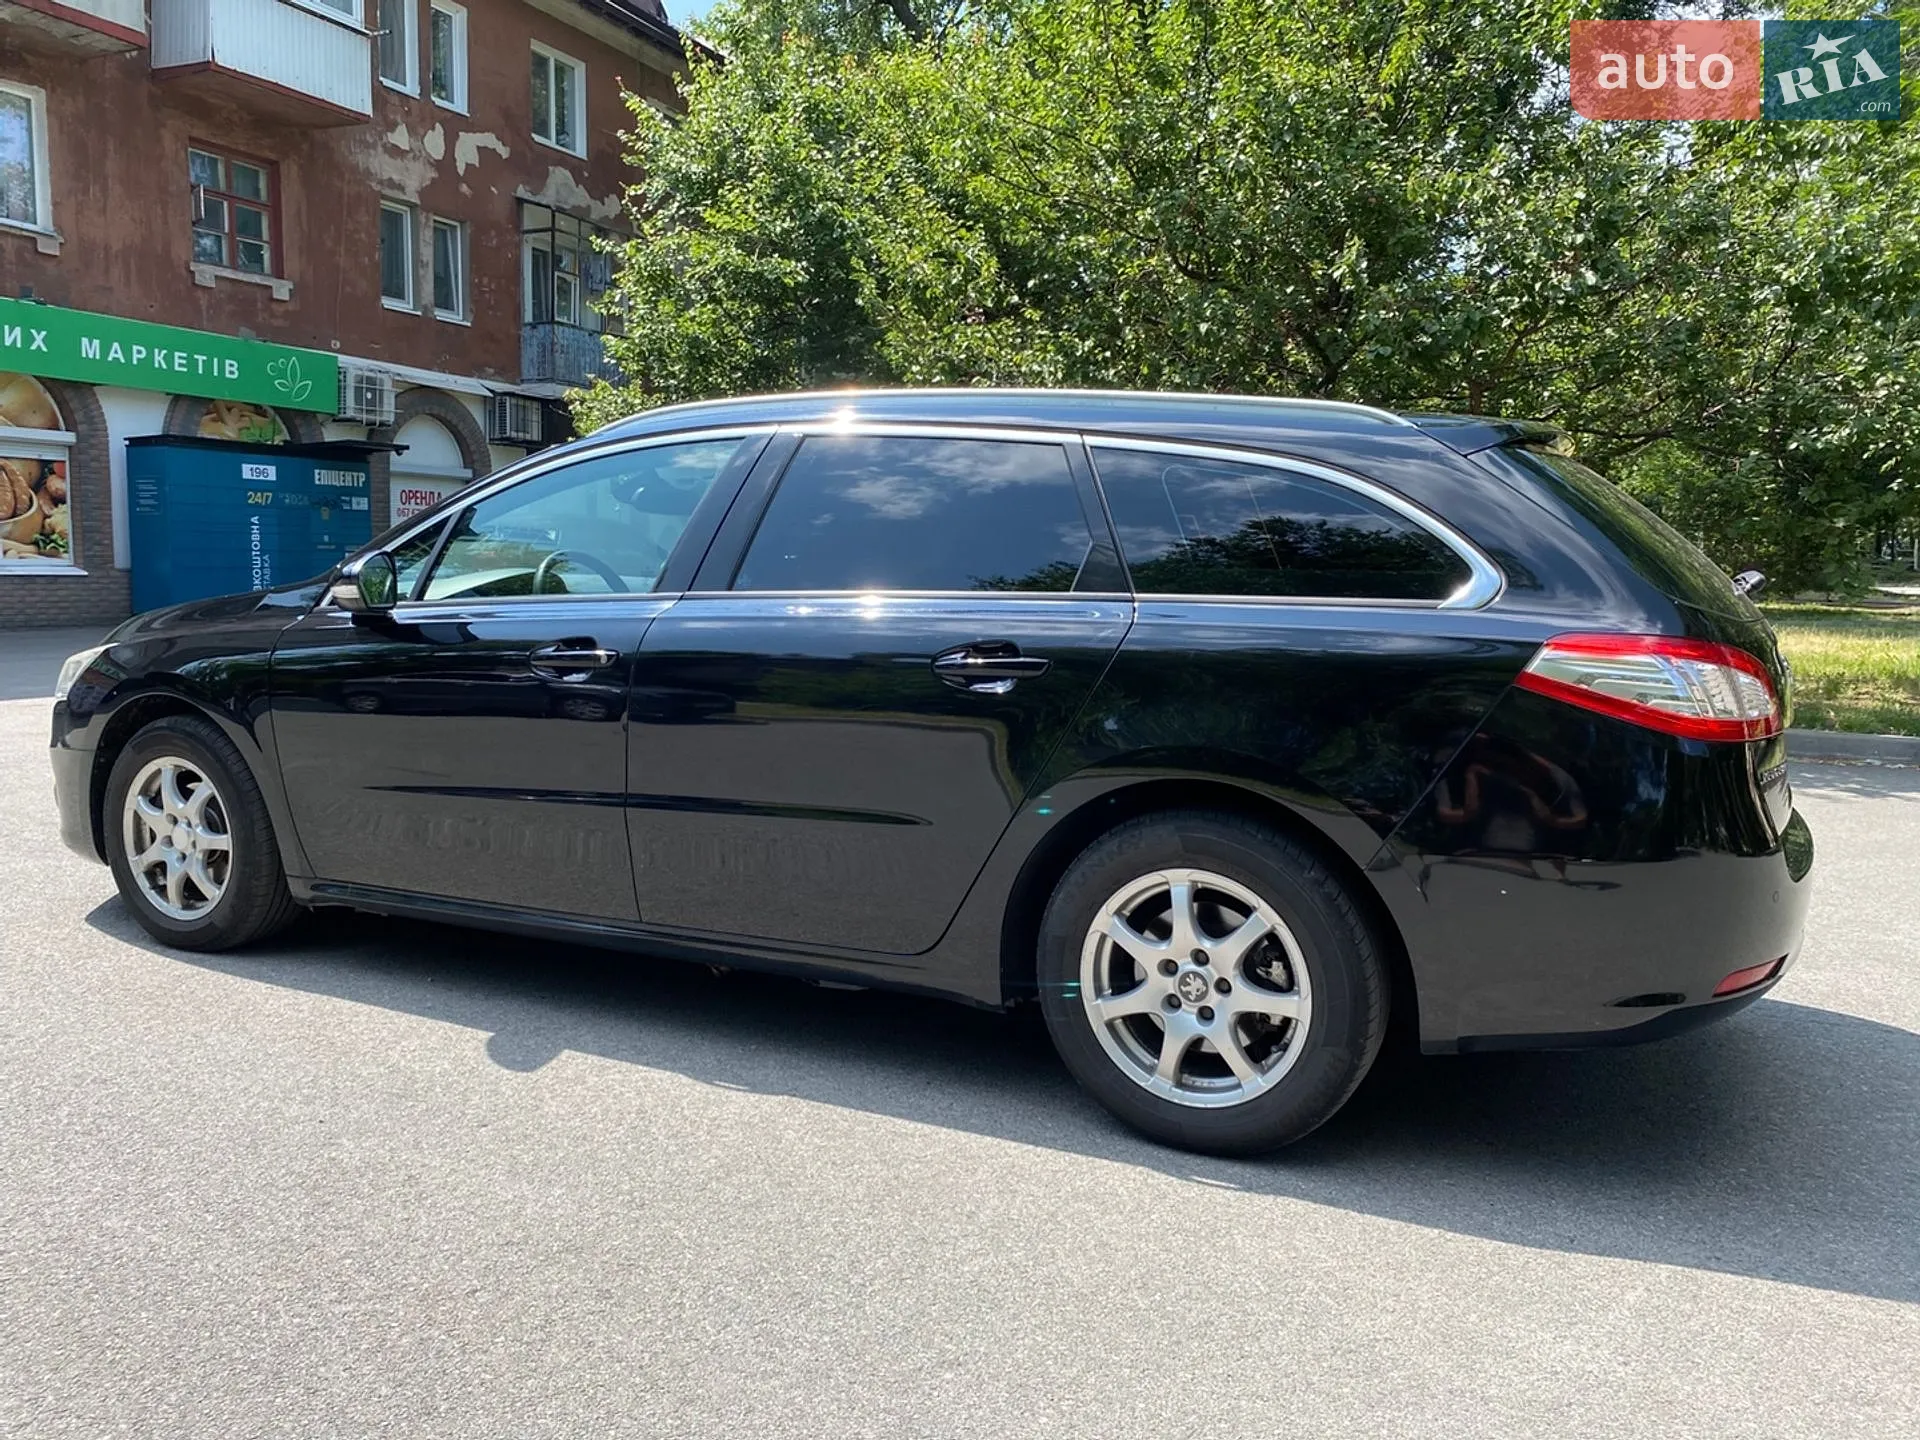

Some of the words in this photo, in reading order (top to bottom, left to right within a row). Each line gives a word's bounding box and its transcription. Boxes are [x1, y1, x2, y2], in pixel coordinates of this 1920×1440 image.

[4, 325, 48, 352] ИХ
[81, 337, 239, 380] МАРКЕТІВ
[249, 468, 270, 479] 196
[314, 469, 366, 487] ЕПІЦЕНТР
[247, 491, 273, 506] 24/7
